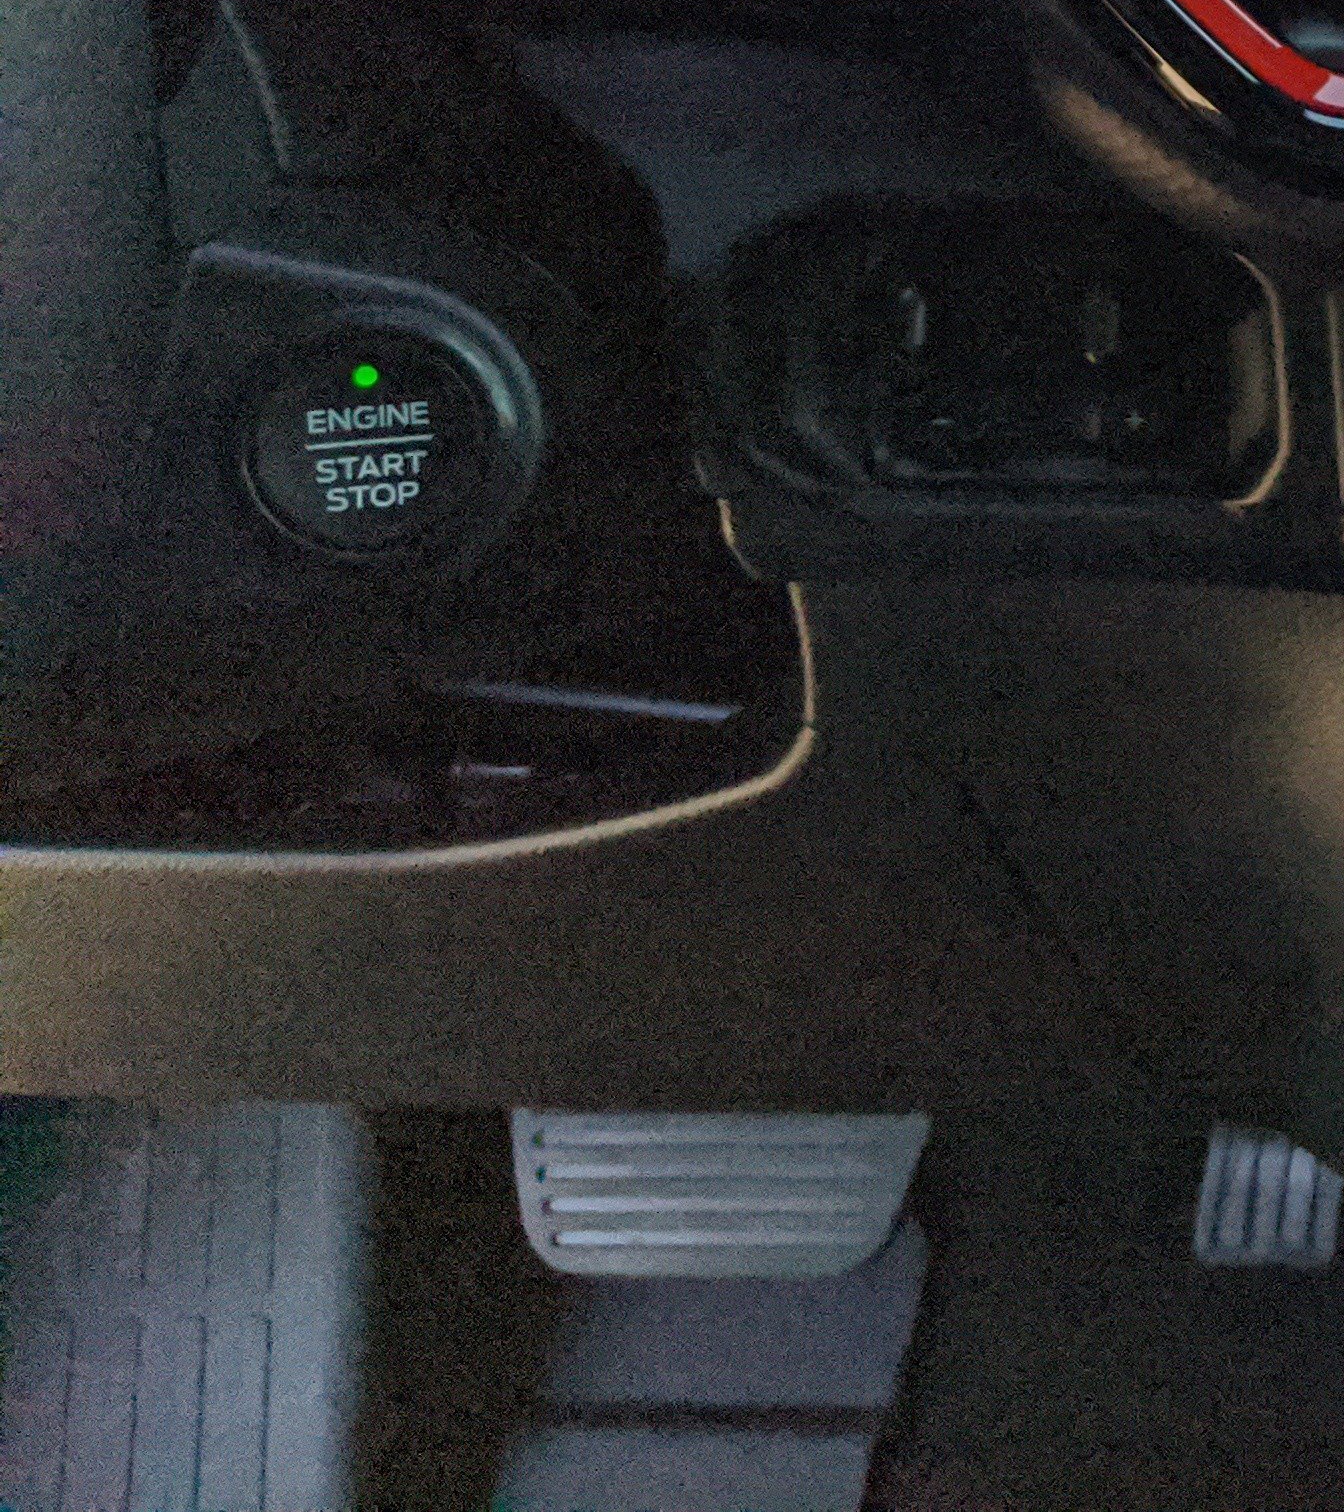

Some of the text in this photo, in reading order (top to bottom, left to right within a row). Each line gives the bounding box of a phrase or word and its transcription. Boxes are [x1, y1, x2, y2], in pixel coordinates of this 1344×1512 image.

[306, 401, 430, 434] ENGINE
[315, 450, 428, 485] START
[326, 481, 419, 513] STOP
